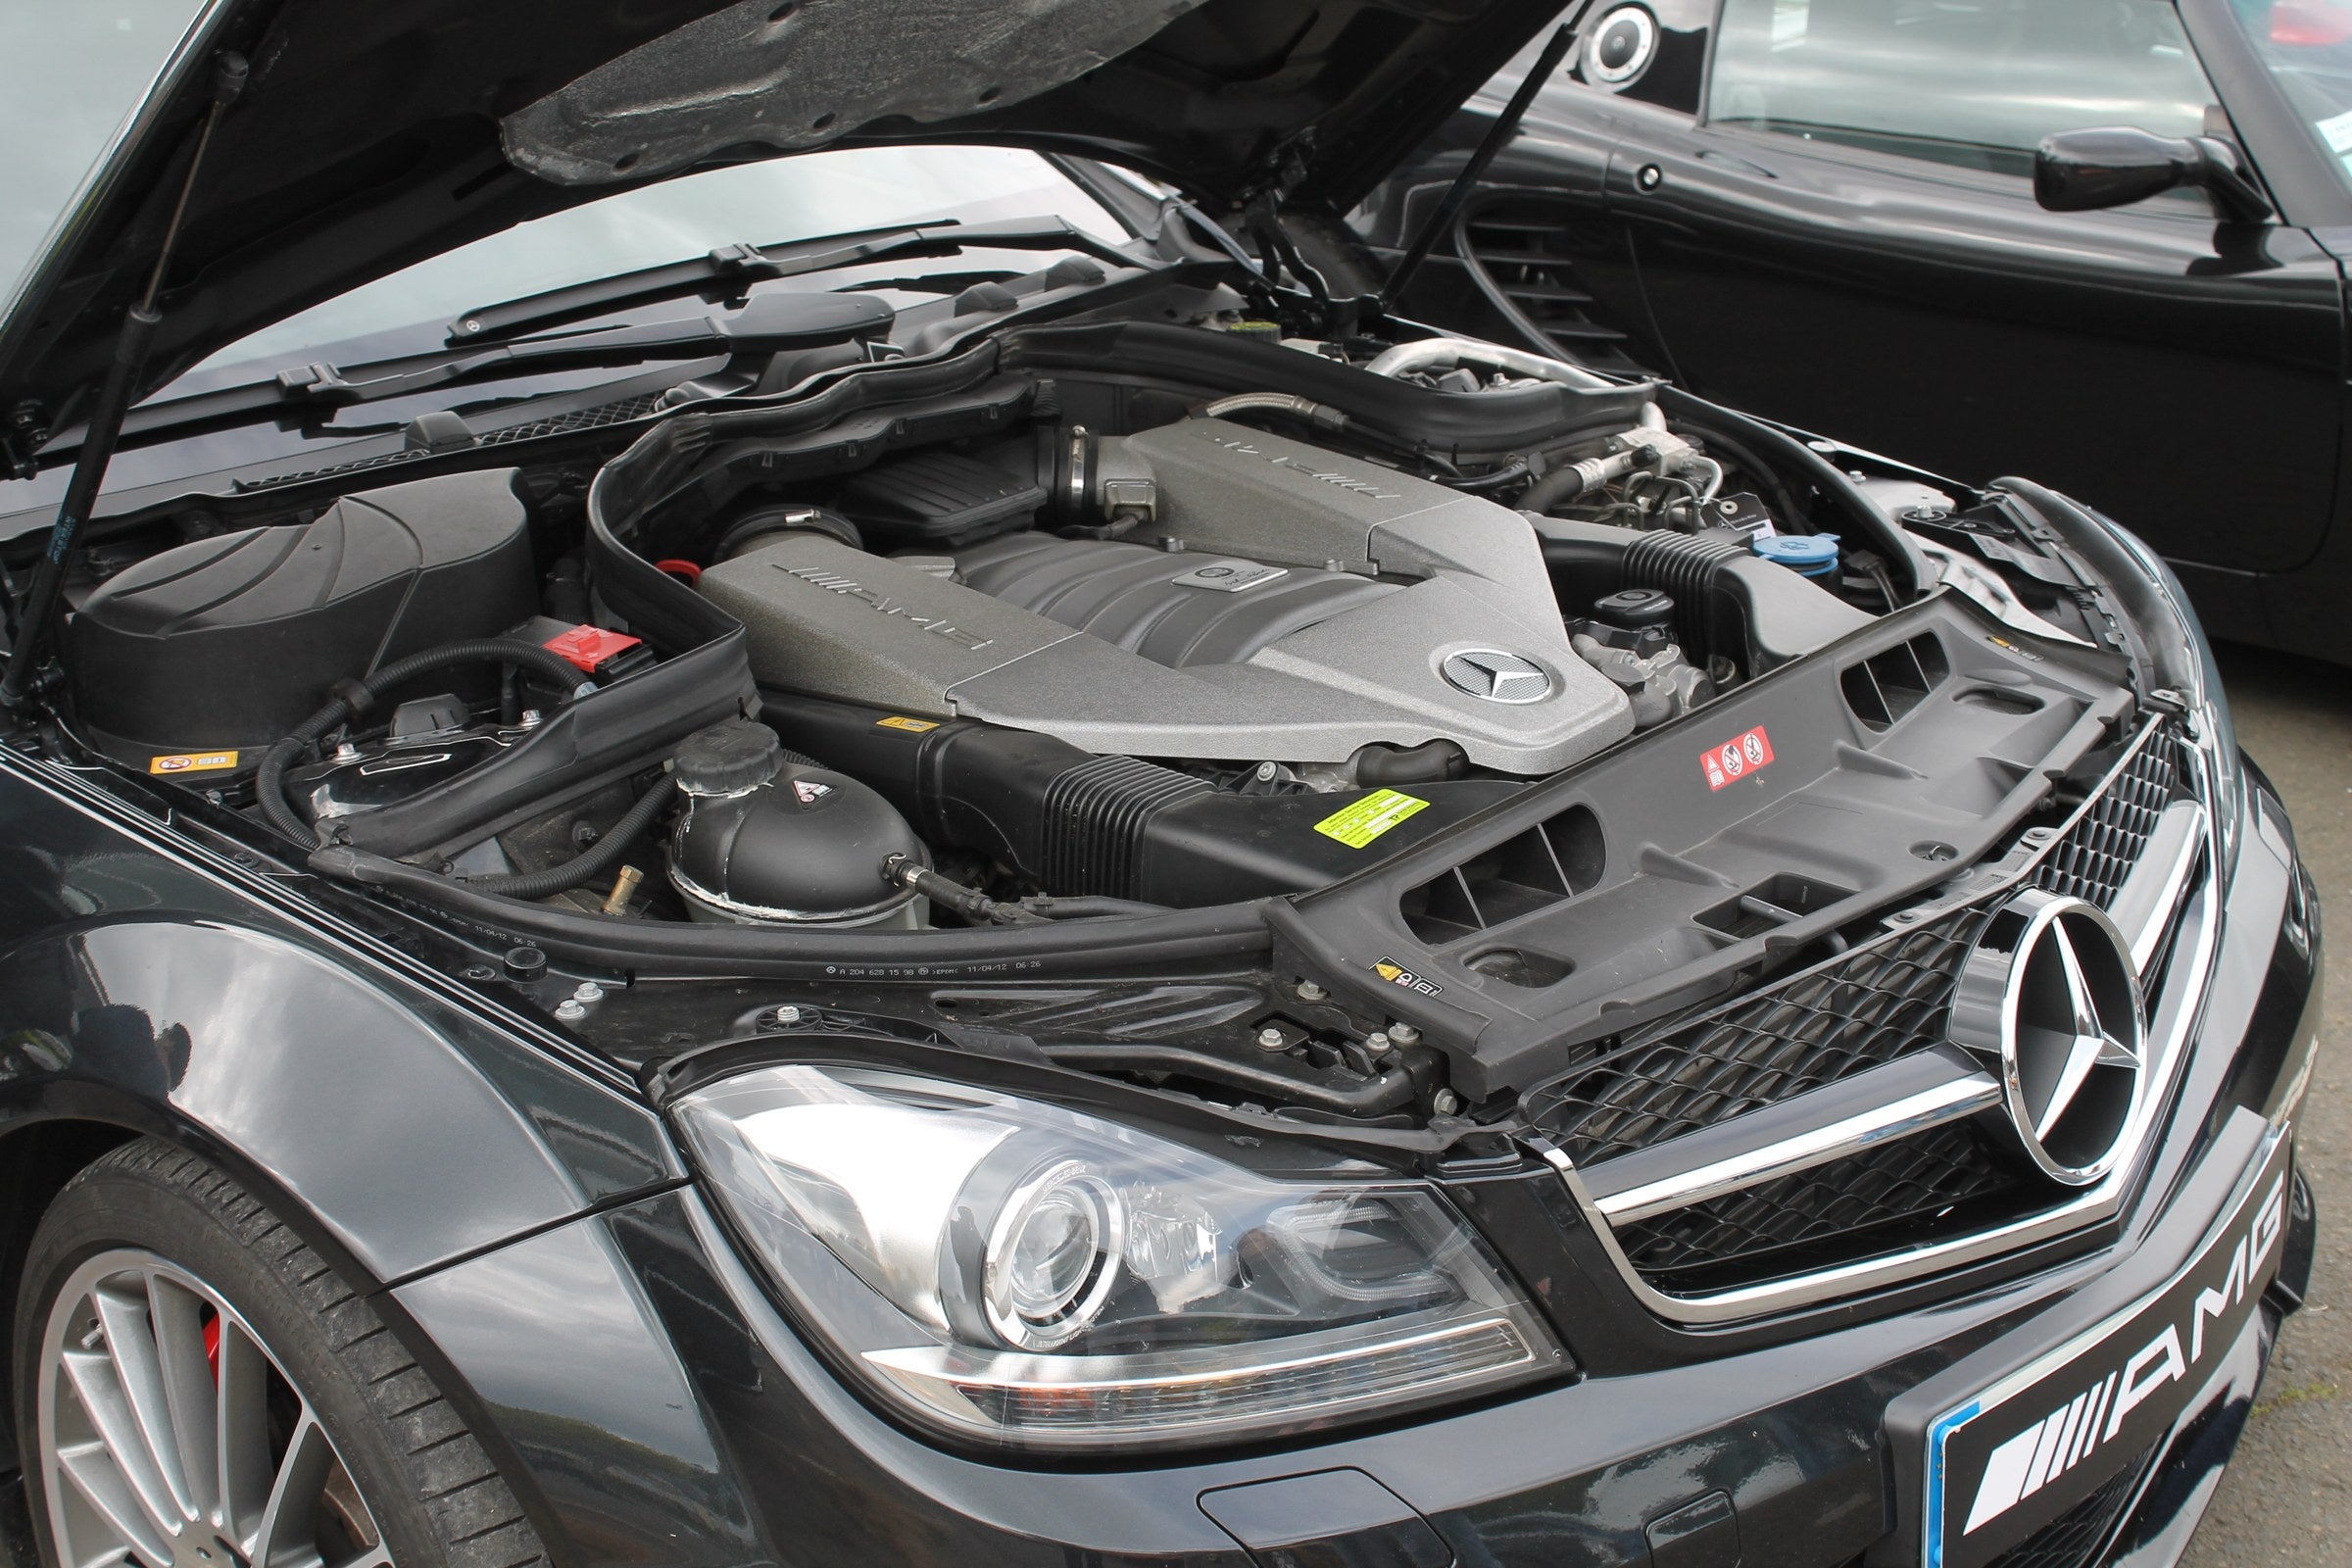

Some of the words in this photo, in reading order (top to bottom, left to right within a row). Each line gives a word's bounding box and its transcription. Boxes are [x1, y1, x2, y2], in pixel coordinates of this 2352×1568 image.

[838, 587, 994, 651] AMG
[967, 963, 1007, 973] 11/04/12
[2102, 1170, 2284, 1445] AMG
